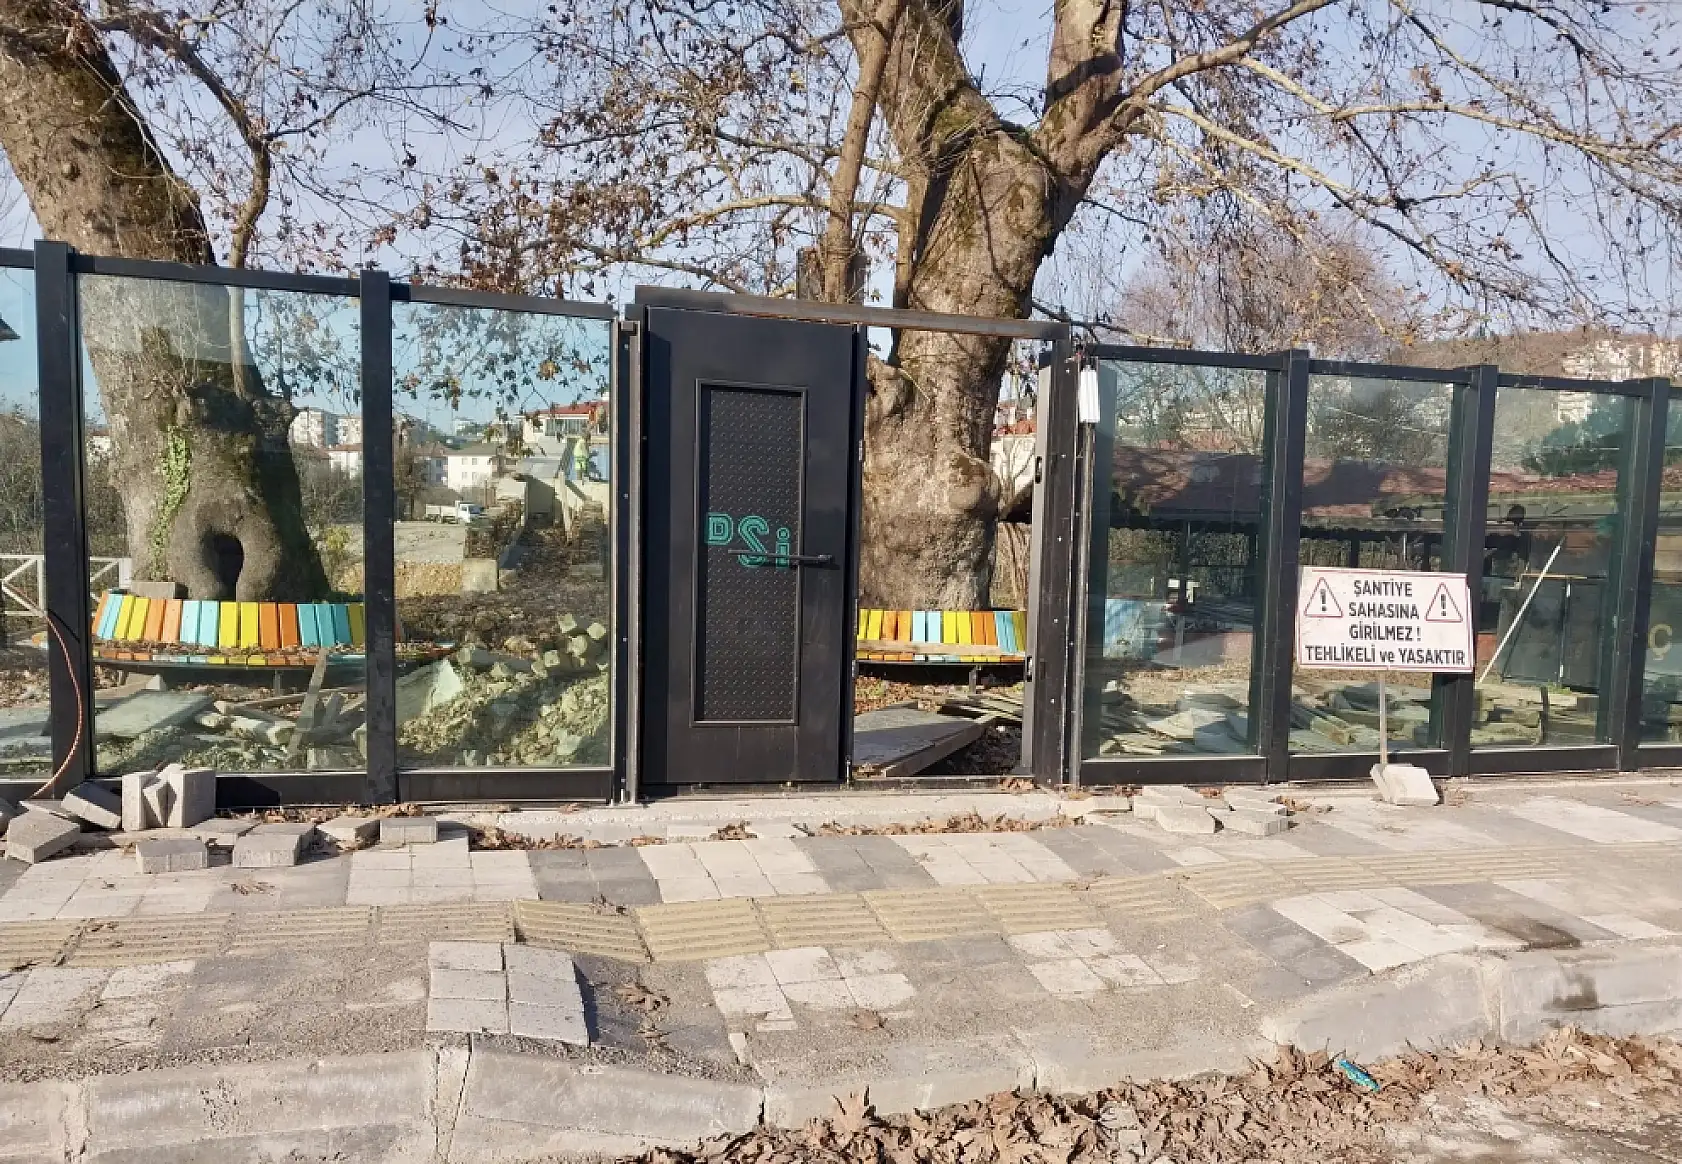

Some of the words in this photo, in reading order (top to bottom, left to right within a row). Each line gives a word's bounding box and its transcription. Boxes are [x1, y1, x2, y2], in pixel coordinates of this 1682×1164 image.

[1354, 578, 1413, 597] ŞANTİYE
[1349, 602, 1420, 620] SAHASINA
[1305, 643, 1376, 663] TEHLİKELİ
[1379, 650, 1395, 663] ve
[1398, 648, 1466, 665] YASAKTIR
